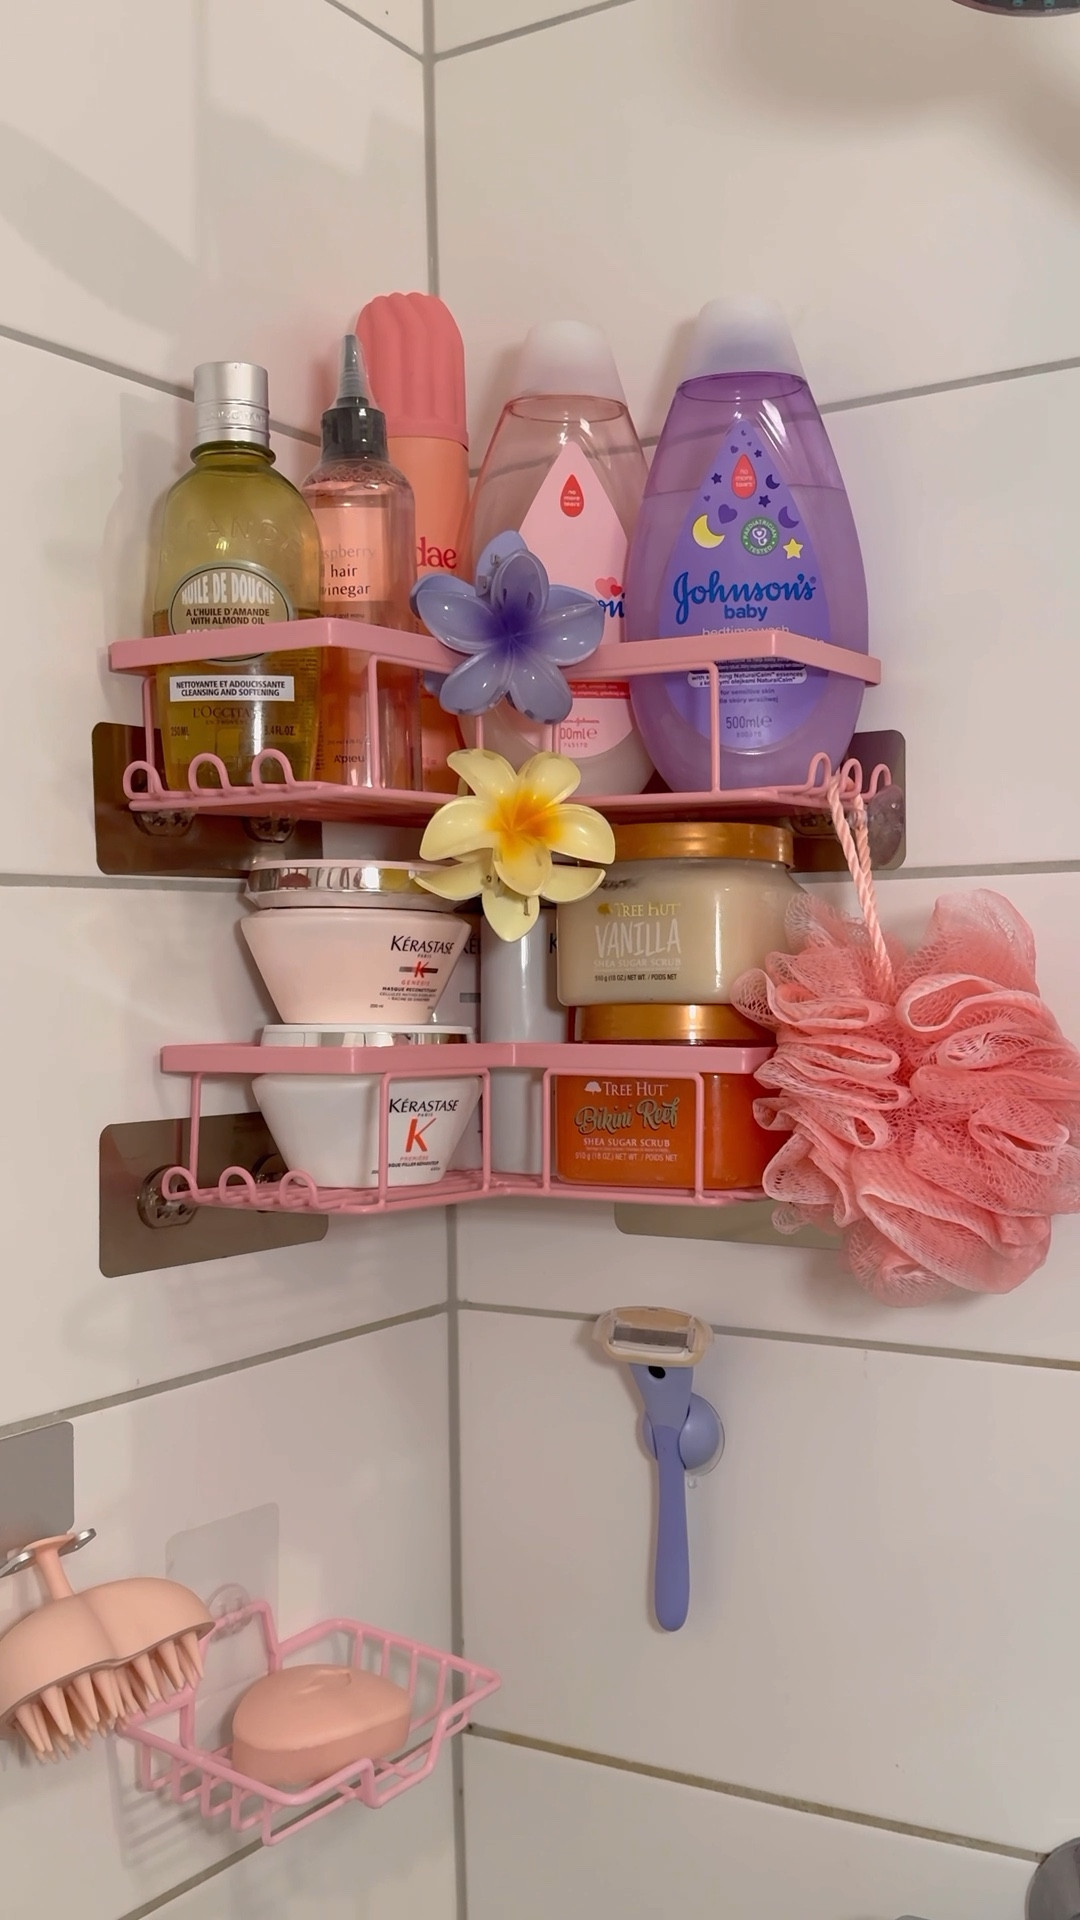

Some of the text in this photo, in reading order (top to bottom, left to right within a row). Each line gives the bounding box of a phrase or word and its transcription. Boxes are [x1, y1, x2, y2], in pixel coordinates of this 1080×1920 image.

[744, 519, 777, 539] PAEDIATRICIAN
[416, 536, 457, 570] dae
[749, 545, 773, 555] TESTED
[331, 564, 358, 578] hair
[182, 572, 275, 605] HUILE DE DOUCHE
[673, 570, 816, 625] Johnson's
[193, 608, 222, 617] L'HUILE
[224, 608, 270, 617] D'AMANDE
[724, 604, 768, 622] baby
[191, 617, 265, 625] WITH ALMOND OIL
[176, 680, 286, 689] NETTOYANTE ET ADOUCISSANTE
[181, 689, 219, 697] CLEANSING
[239, 689, 280, 697] SOFTENING
[560, 728, 586, 740] 00ml
[615, 902, 680, 917] TREE HUT
[391, 935, 455, 955] KÉRASTASE
[595, 918, 681, 959] VANILLA
[414, 961, 430, 978] K
[594, 958, 681, 968] SHEA SUGAR SCRUB
[602, 1081, 666, 1096] TREE HUT
[389, 1098, 459, 1114] KÉRASTASE
[574, 1097, 680, 1135] Bikini Reef
[405, 1118, 437, 1153] K
[584, 1138, 670, 1148] SHEA SUGAR SCRUB
[615, 1153, 627, 1161] NET
[645, 1153, 664, 1161] POIDS
[665, 1154, 678, 1162] NET
